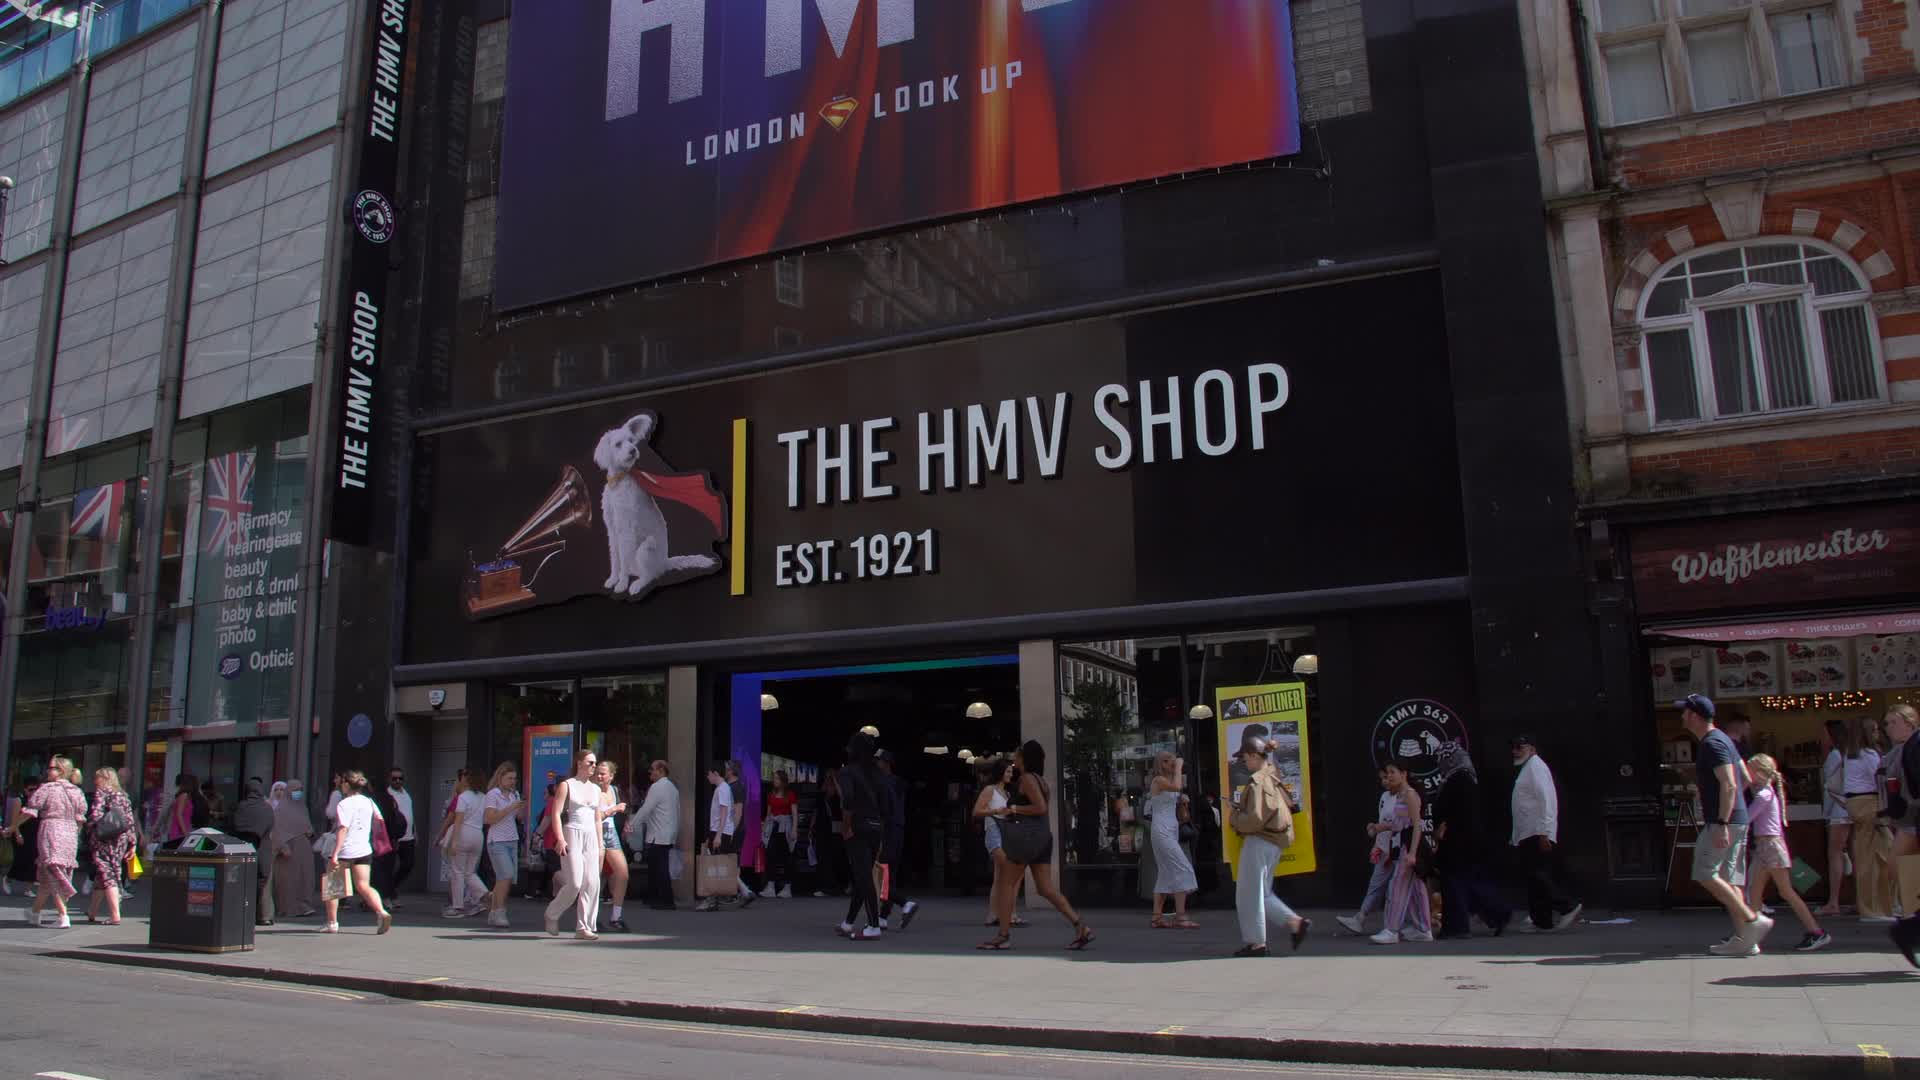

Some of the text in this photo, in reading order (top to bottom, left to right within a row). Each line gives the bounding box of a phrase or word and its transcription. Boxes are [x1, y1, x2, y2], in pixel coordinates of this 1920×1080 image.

[370, 0, 406, 143] THE HMV SH
[686, 61, 1022, 166] LONDON LOOK UP
[342, 291, 378, 489] THE HMV SHOP
[777, 362, 1290, 509] THE HMV SHOP
[226, 509, 291, 534] pharmacy
[226, 530, 303, 557] hearingcare
[1671, 528, 1890, 585] Wafflemeister
[225, 559, 268, 579] beauty
[776, 529, 937, 588] EST. 1921
[224, 581, 252, 600] food
[255, 579, 265, 596] &
[222, 603, 252, 624] baby
[255, 601, 265, 618] &
[219, 626, 256, 648] photo
[250, 647, 295, 672] Opticia
[1246, 689, 1302, 716] HEADLINER
[1385, 704, 1450, 728] HMV 363
